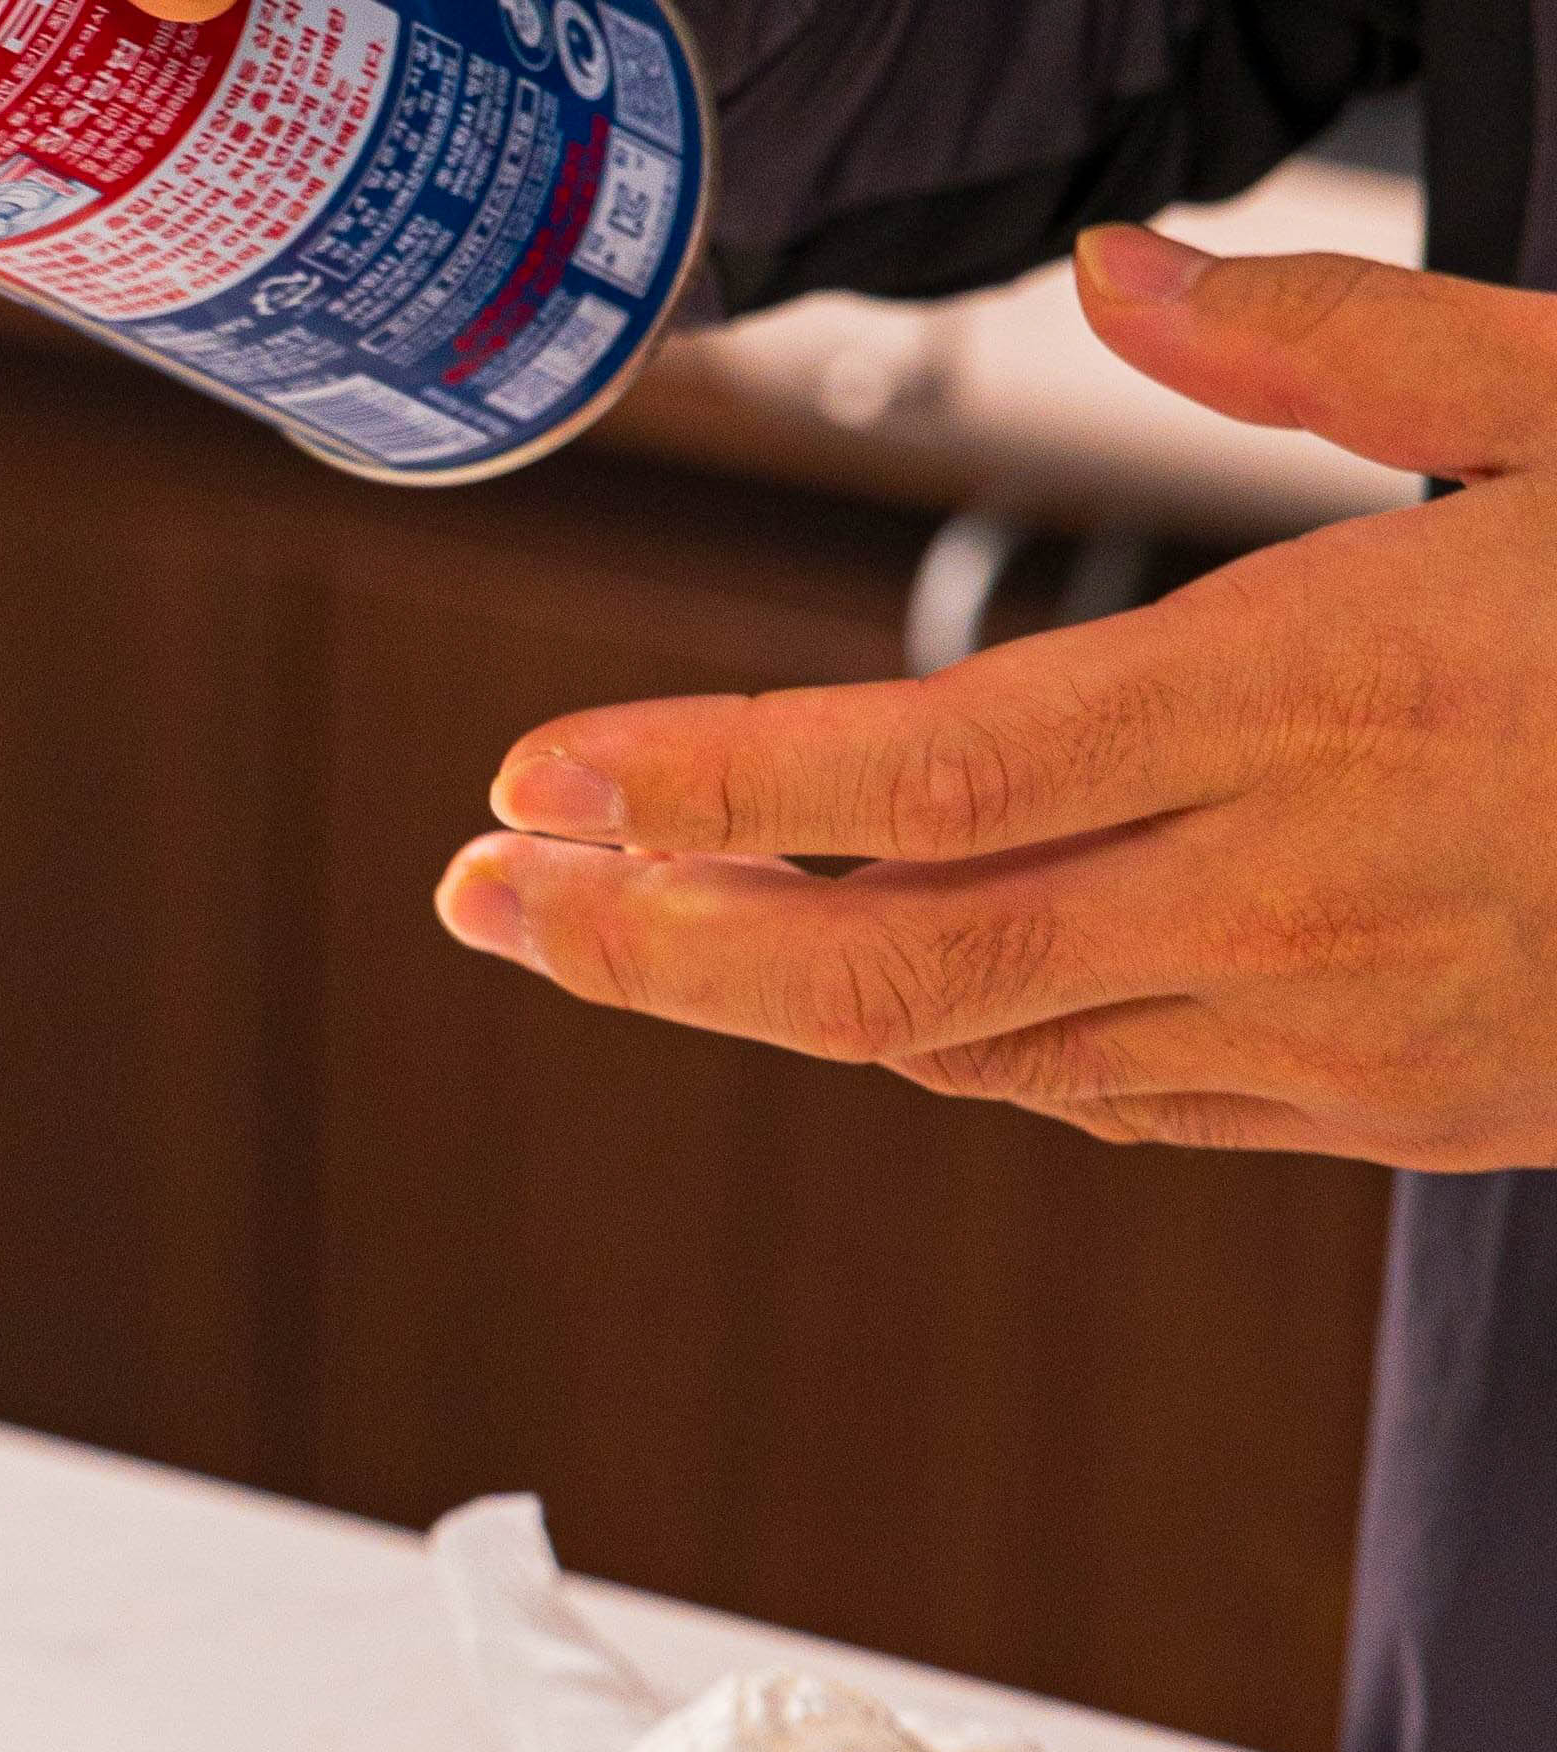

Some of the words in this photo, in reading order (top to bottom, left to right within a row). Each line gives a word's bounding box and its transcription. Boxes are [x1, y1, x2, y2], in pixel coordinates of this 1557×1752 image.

[23, 33, 146, 158] 장착방법
[50, 1, 112, 80] 부주의시
[130, 131, 158, 152] 후
[144, 45, 215, 138] 점화하십시오
[208, 118, 255, 169] 이를
[245, 32, 294, 116] 흡입한
[54, 126, 107, 166] 그림과
[91, 100, 129, 132] 같이
[113, 58, 158, 106] 용기의
[153, 184, 232, 244] 의하여
[223, 110, 286, 186] 처벌을
[275, 23, 320, 110] 받으며
[215, 186, 291, 252] 이하의
[281, 132, 327, 187] 징역
[315, 74, 352, 132] 또는
[227, 90, 322, 214] 청소년에게
[308, 2, 346, 93] 판매한
[97, 177, 178, 232] 흡입시
[185, 240, 266, 292] 이하의
[258, 175, 328, 245] 벌금에
